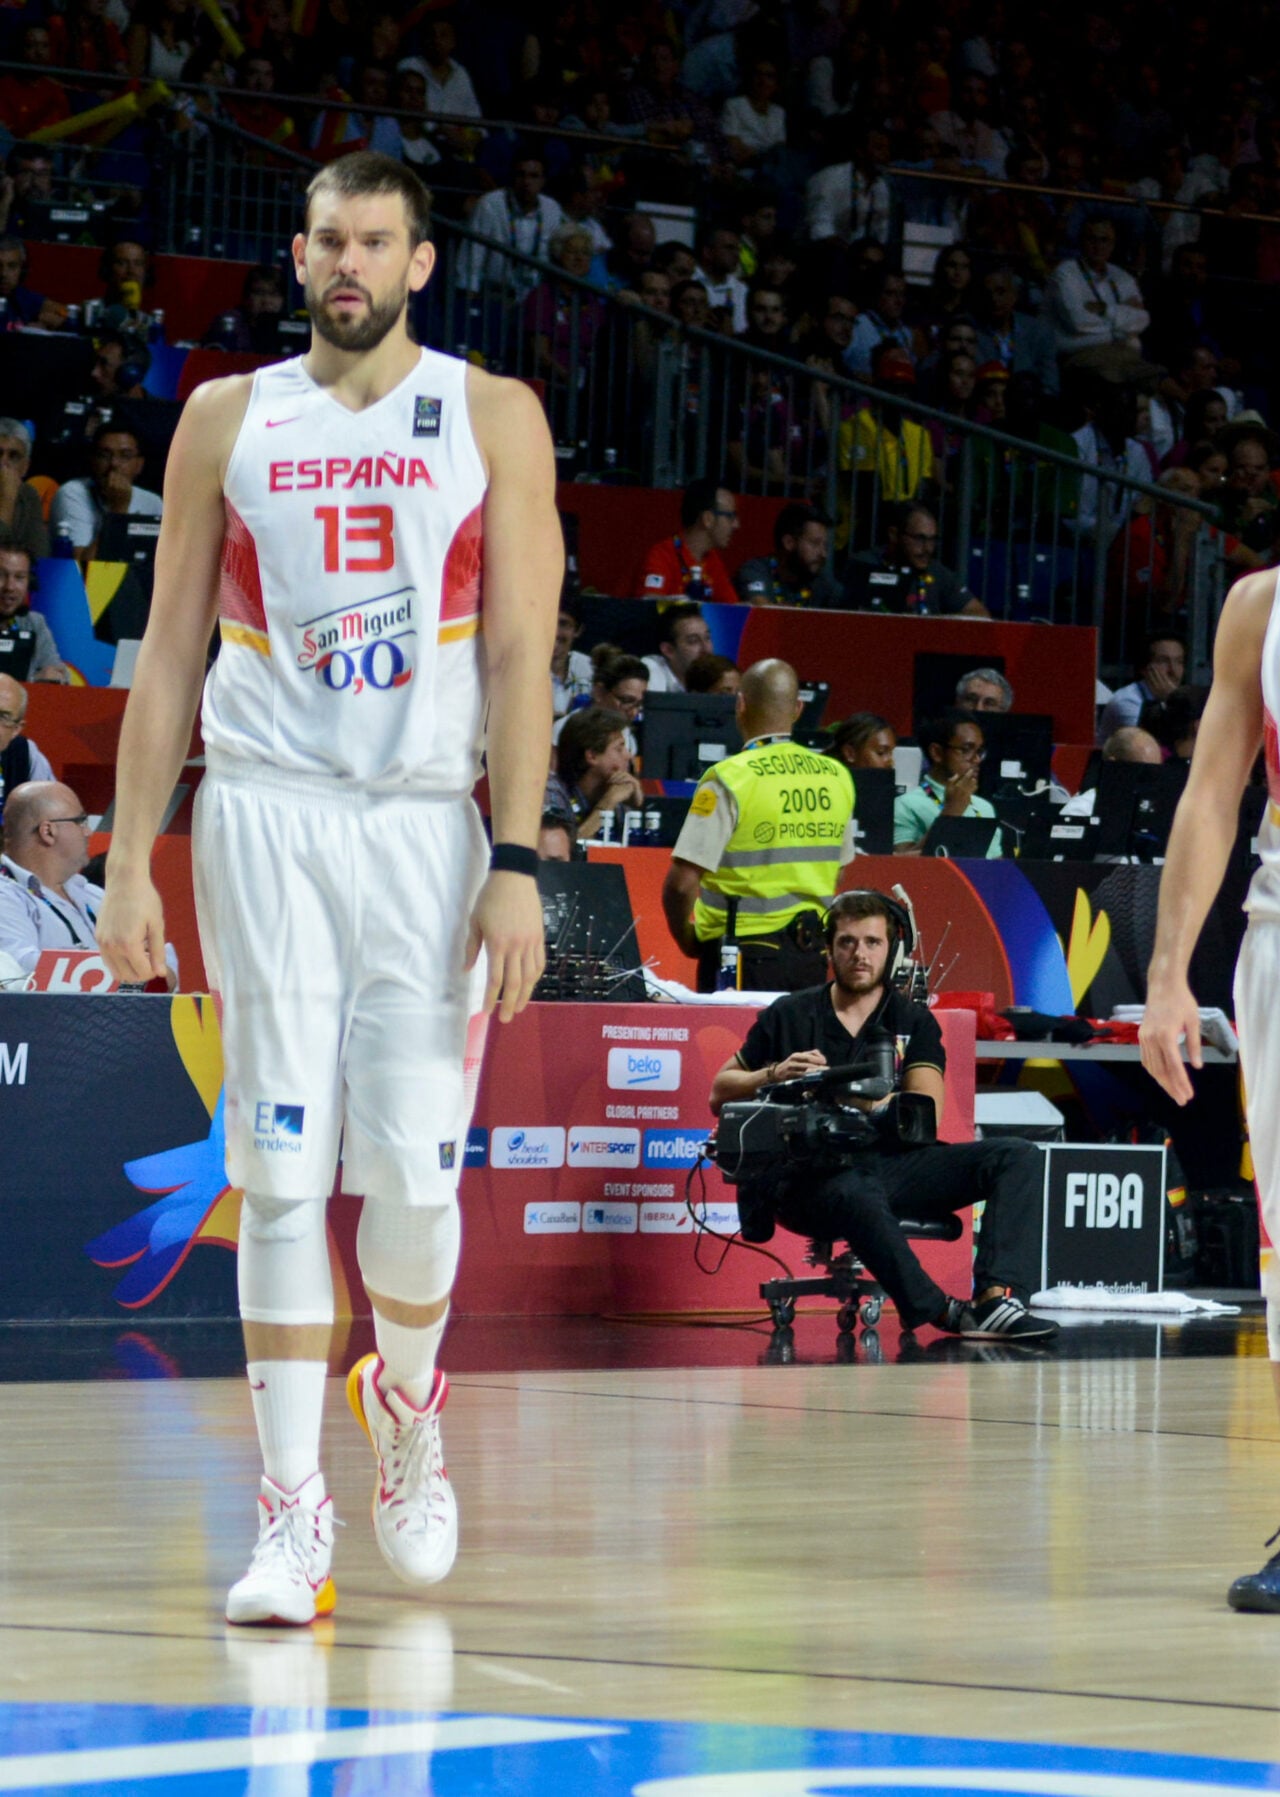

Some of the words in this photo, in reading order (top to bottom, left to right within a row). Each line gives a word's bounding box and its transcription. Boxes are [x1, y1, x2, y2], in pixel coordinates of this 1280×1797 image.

[416, 418, 438, 429] FIBA
[269, 451, 438, 492] ESPAÑA
[313, 504, 395, 573] 13
[297, 622, 338, 664] San
[337, 598, 412, 641] Miguel
[319, 639, 406, 694] 0,0
[747, 752, 839, 777] SEGURIDAD
[779, 787, 832, 814] 2006
[602, 1025, 651, 1040] PRESENTING
[652, 1027, 689, 1041] PARTNER
[627, 1055, 662, 1073] beko
[606, 1104, 636, 1119] GLOBAL
[637, 1106, 679, 1120] PARTNERS
[254, 1138, 302, 1152] endesa
[580, 1142, 637, 1154] INTERSPORT
[604, 1183, 631, 1195] EVENT
[632, 1184, 675, 1197] SPONSORS
[1065, 1172, 1145, 1229] FIBA
[644, 1212, 676, 1221] IBERIA
